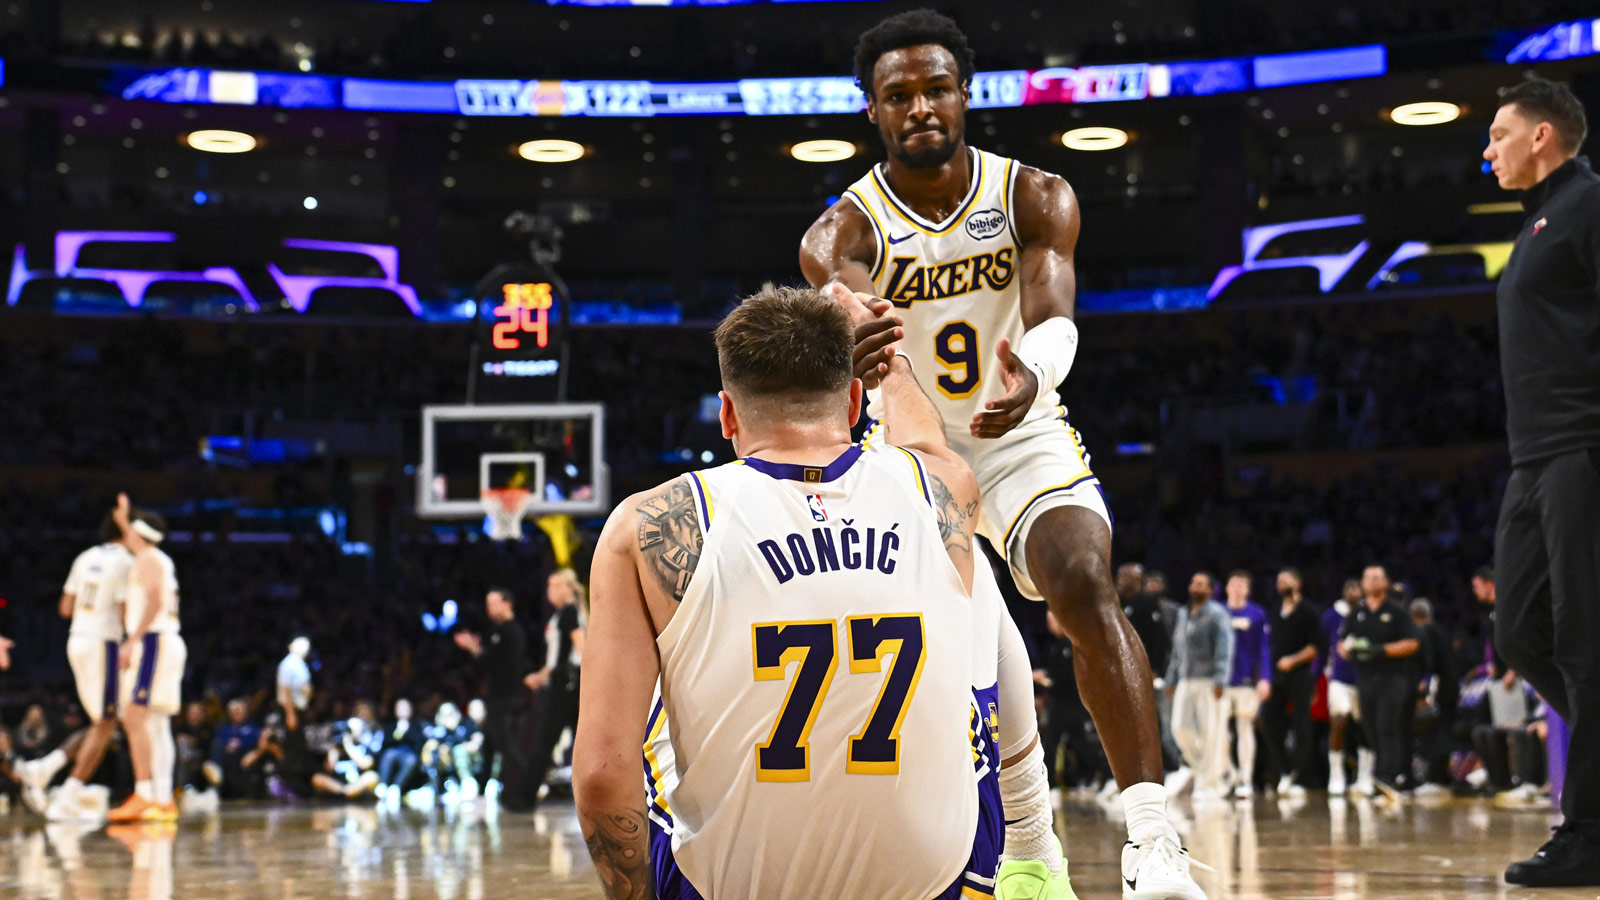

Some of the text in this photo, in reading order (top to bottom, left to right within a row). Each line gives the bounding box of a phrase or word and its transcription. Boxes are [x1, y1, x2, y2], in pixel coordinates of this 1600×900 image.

[968, 216, 1004, 231] bibigo
[881, 246, 1015, 310] LAKERS
[493, 306, 548, 349] 24
[934, 319, 982, 400] 9
[757, 518, 900, 584] DONČIĆ
[751, 612, 927, 782] 77
